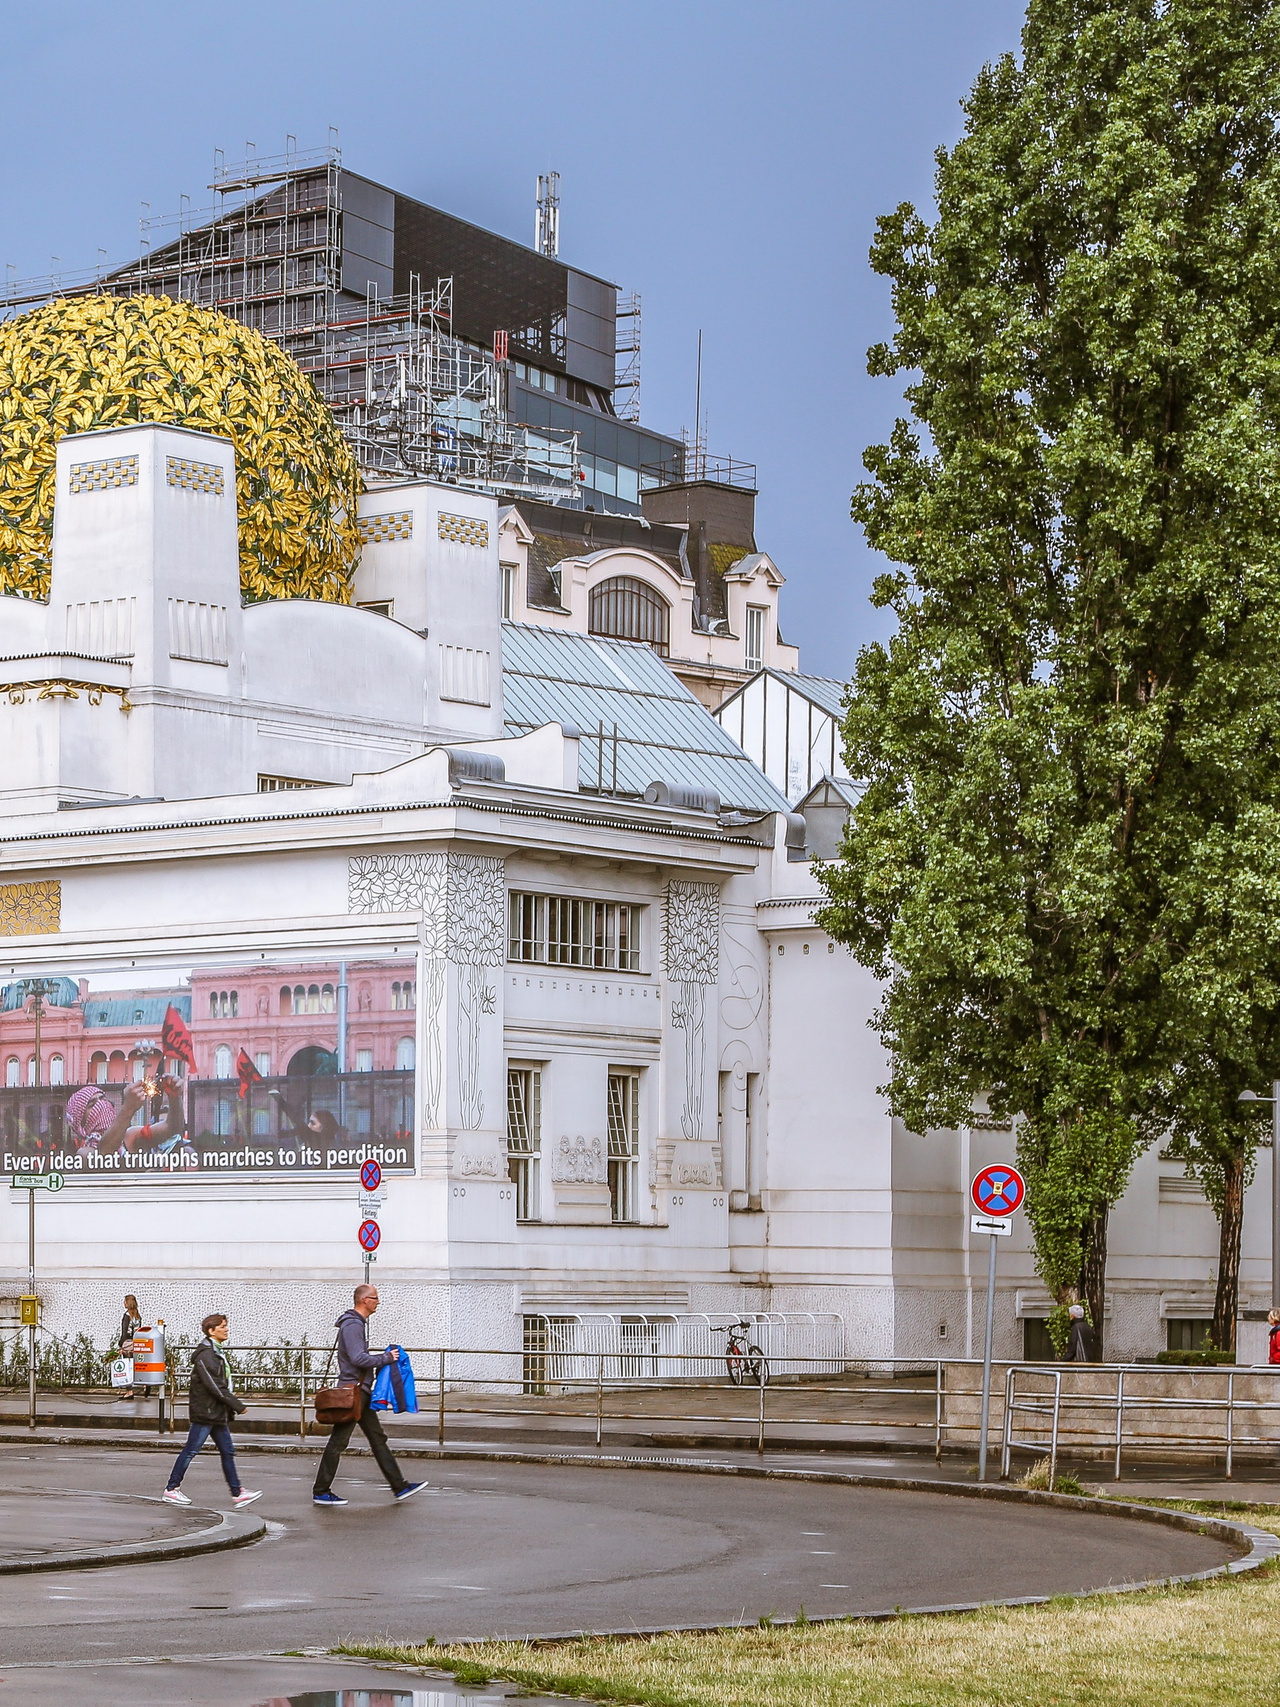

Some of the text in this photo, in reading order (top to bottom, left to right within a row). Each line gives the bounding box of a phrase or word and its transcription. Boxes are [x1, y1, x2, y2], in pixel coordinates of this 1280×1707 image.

[3, 1144, 408, 1174] Every idea that triumphs marches to its perdition
